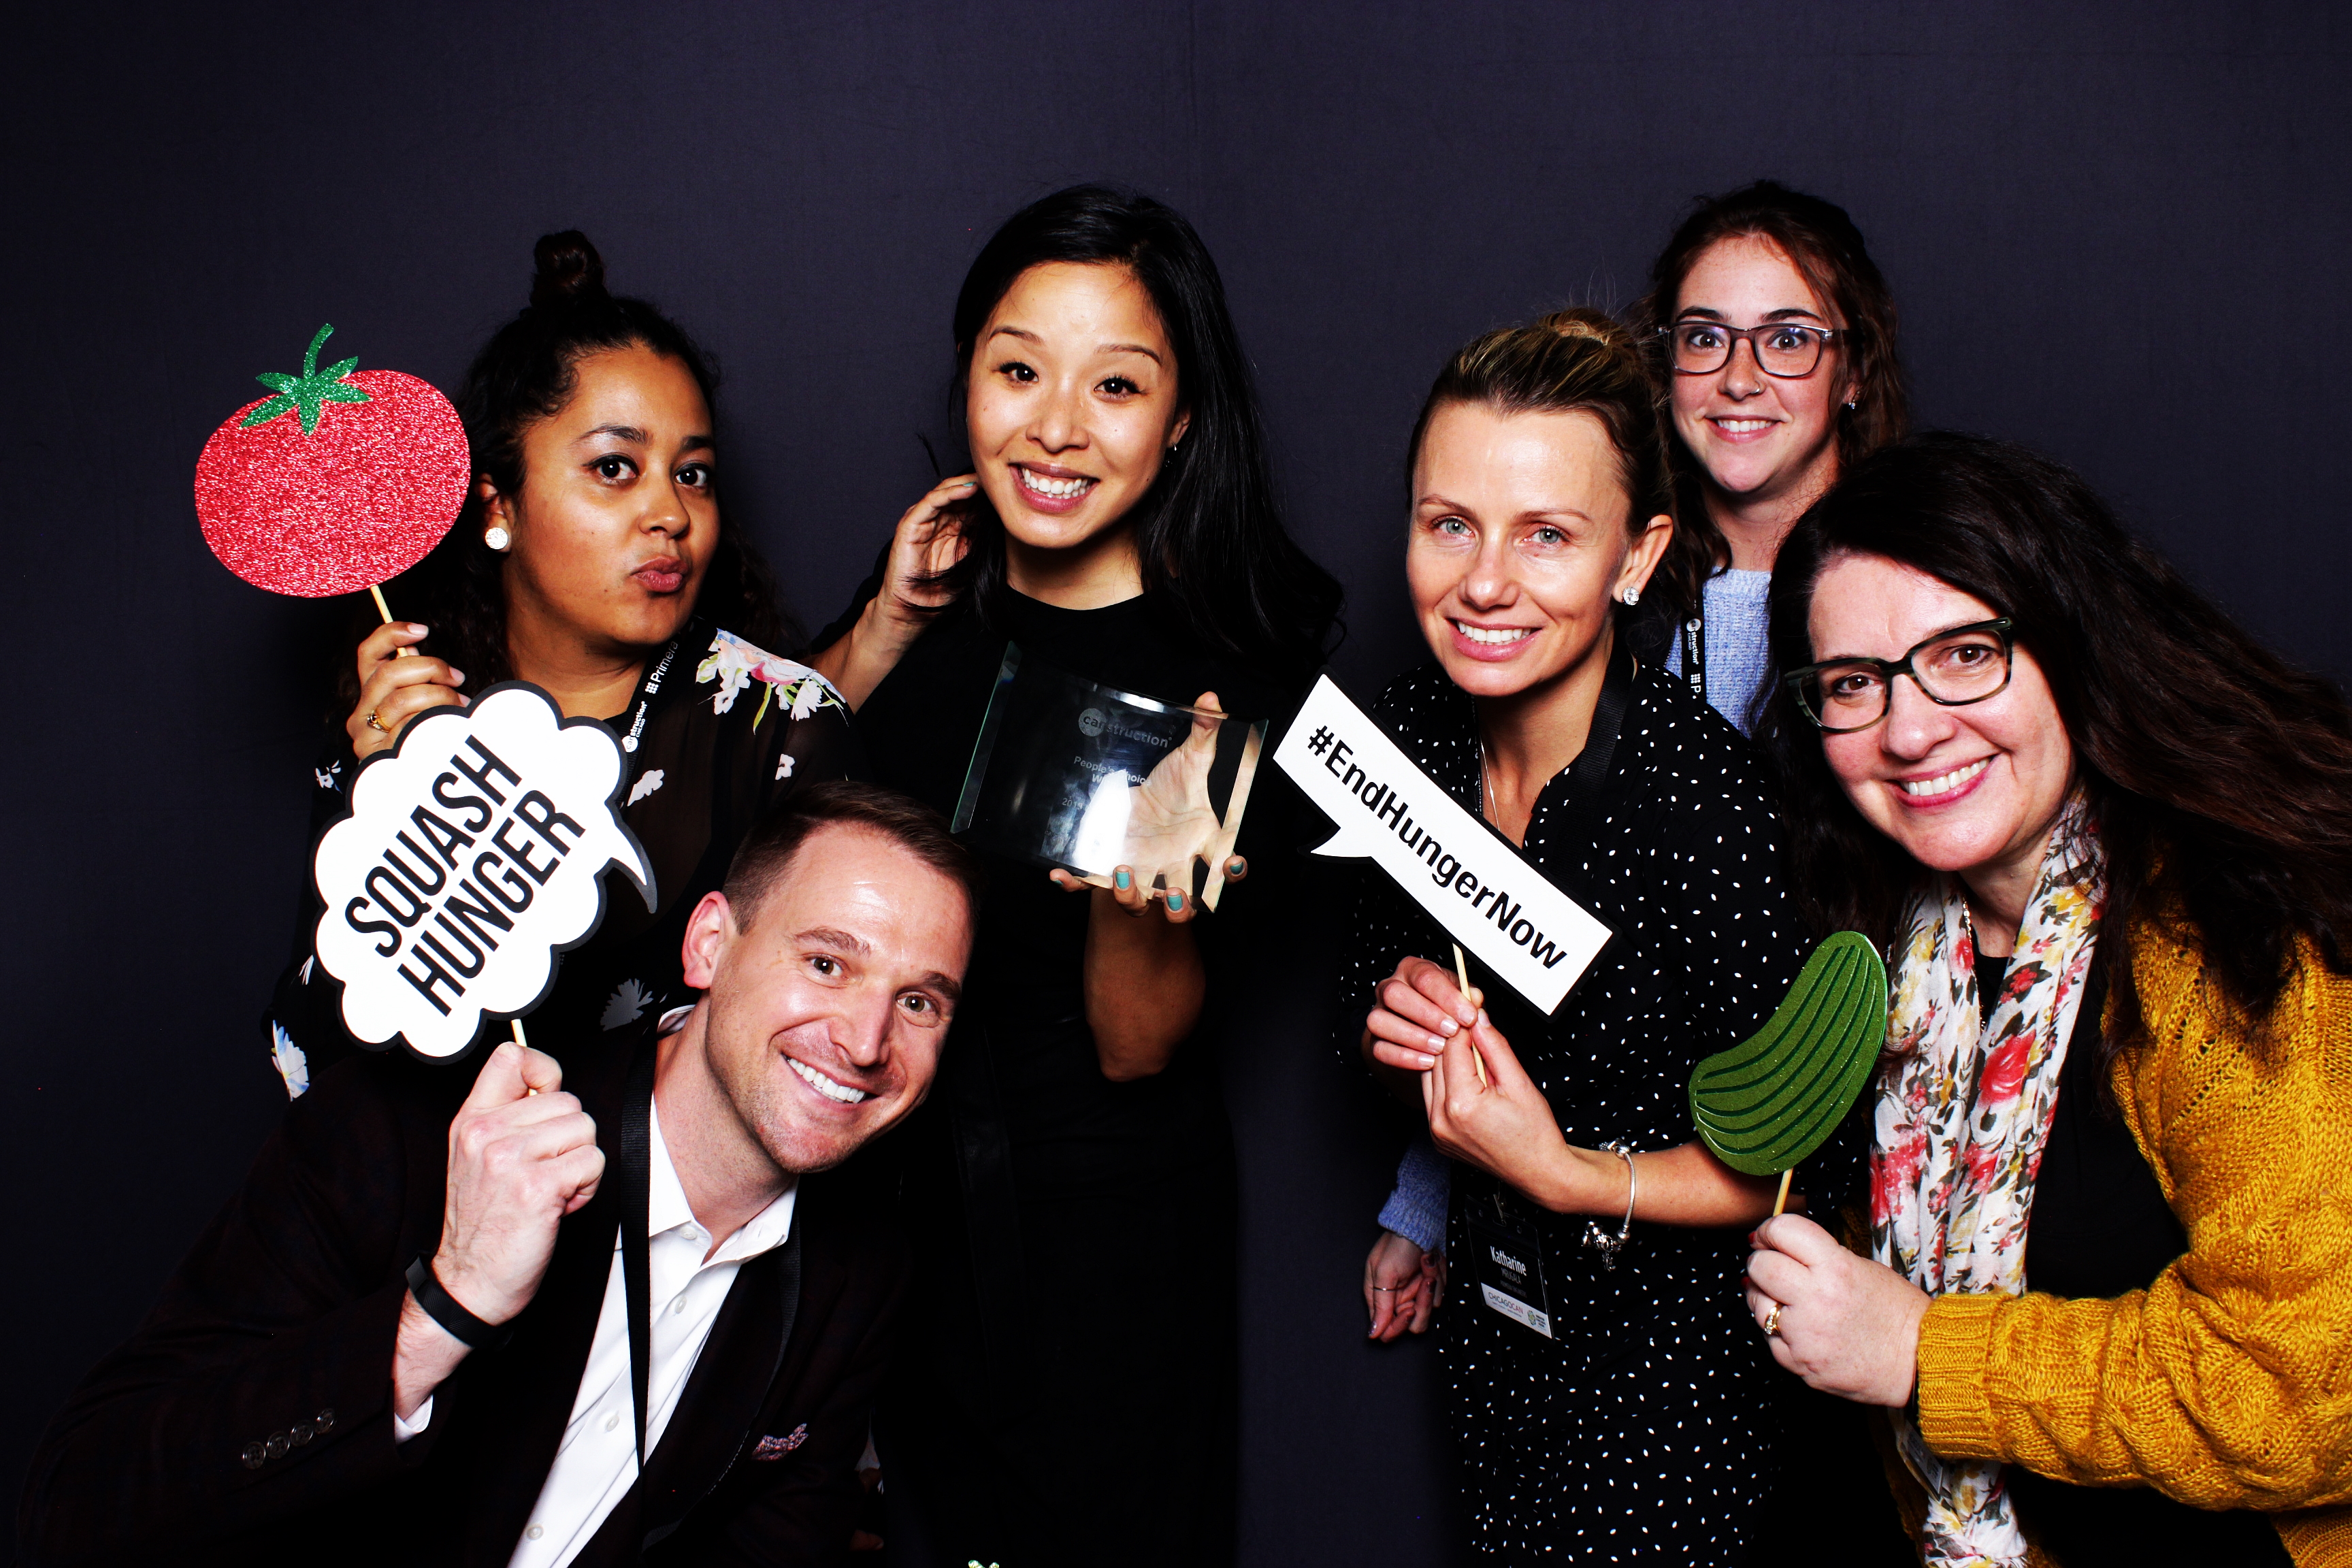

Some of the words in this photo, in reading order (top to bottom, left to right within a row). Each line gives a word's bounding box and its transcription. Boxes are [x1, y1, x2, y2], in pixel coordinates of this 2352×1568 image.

[650, 641, 679, 683] Primera
[345, 734, 522, 958] SQUASH
[397, 790, 586, 1017] HUNGER
[1307, 725, 1567, 969] #EndHungerNow
[1490, 1245, 1527, 1277] Katharine
